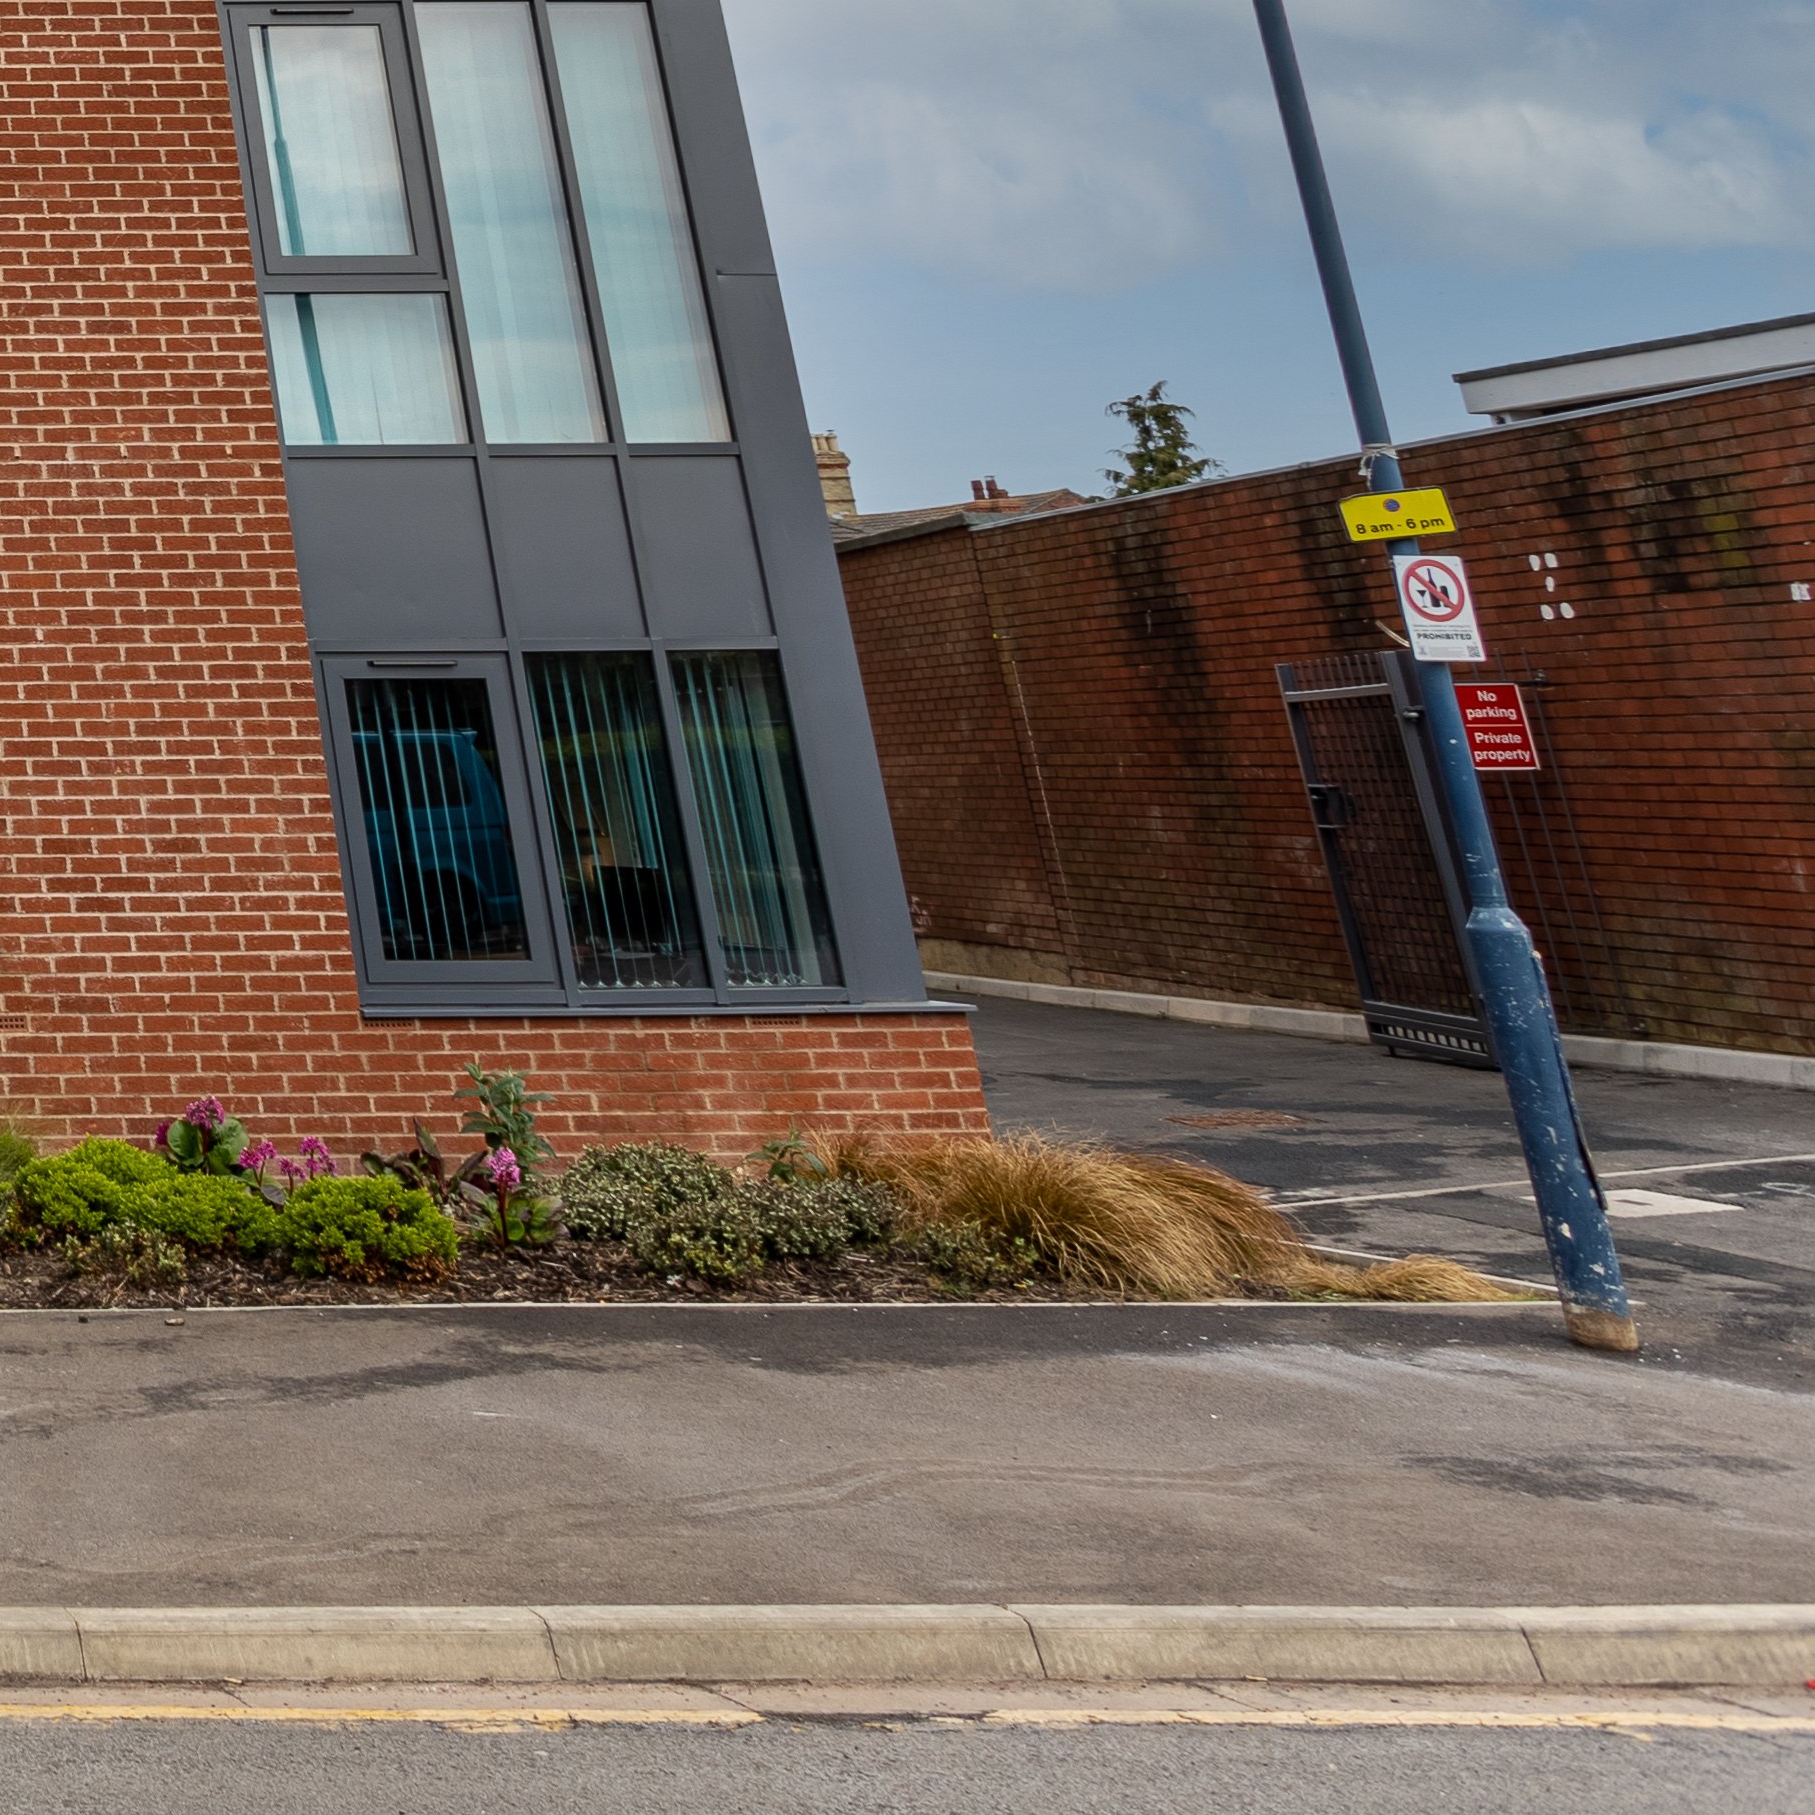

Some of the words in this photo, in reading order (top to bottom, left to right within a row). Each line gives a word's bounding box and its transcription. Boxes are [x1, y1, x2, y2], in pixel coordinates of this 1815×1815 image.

[1356, 523, 1366, 534] 8
[1370, 523, 1394, 533] am
[1406, 518, 1416, 529] 6
[1420, 518, 1445, 530] pm
[1416, 632, 1472, 641] PROHIBITED
[1476, 690, 1497, 702] No
[1465, 706, 1517, 721] parking
[1474, 732, 1522, 744] Private
[1473, 749, 1531, 762] property
